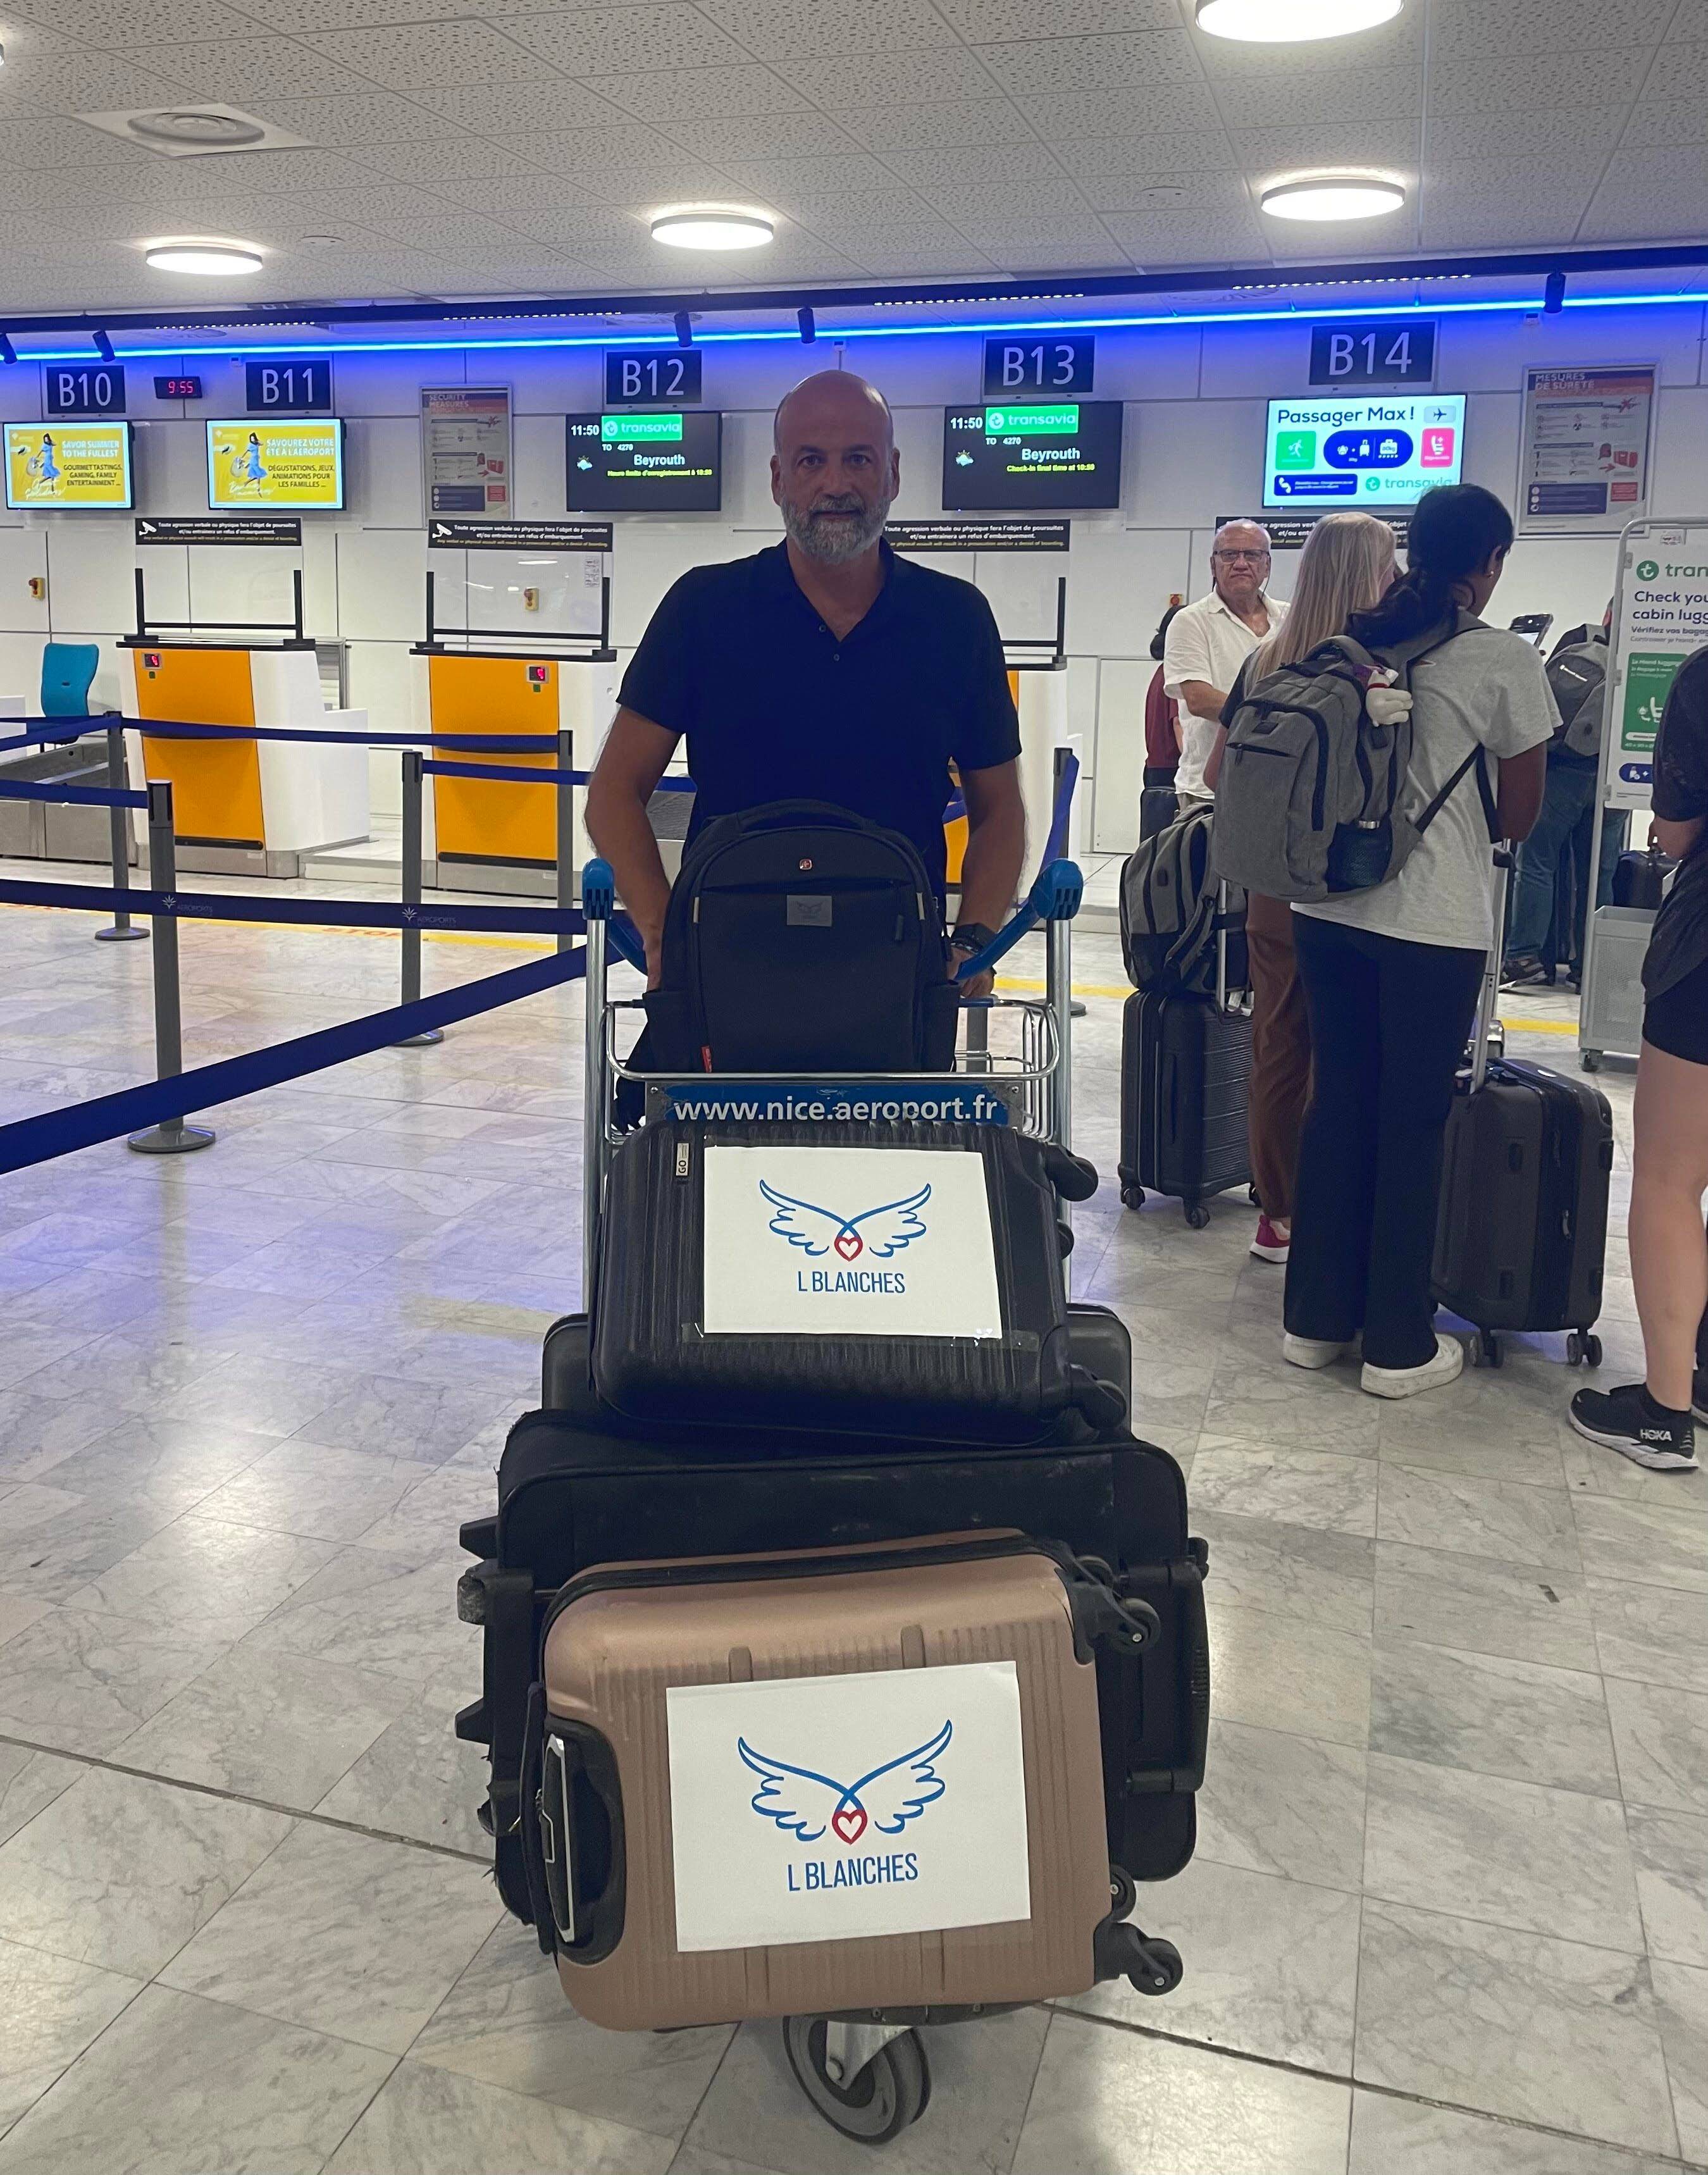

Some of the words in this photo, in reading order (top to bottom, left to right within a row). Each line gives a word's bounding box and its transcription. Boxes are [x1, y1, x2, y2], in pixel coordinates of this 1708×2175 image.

[1329, 332, 1413, 376] B14
[1003, 344, 1075, 387] B13
[622, 358, 684, 397] B12
[1536, 372, 1585, 382] MESURES
[59, 373, 111, 407] B10
[168, 381, 194, 393] 9:55
[263, 368, 313, 404] B11
[1535, 382, 1550, 390] DE
[950, 417, 983, 429] 11:50
[1008, 413, 1076, 425] transavia
[1278, 409, 1363, 428] Passager
[1368, 407, 1406, 421] Max
[571, 424, 600, 436] 11:50
[621, 422, 680, 433] transavia
[1003, 437, 1022, 445] 4270
[88, 449, 118, 457] FULLEST
[1021, 448, 1080, 462] Beyrouth
[634, 454, 686, 468] Beyrouth
[1635, 591, 1681, 602] Check
[1633, 609, 1674, 620] cabin
[1631, 626, 1664, 634] Vérifiez
[674, 1094, 998, 1122] www.nice.aeroport.fr
[678, 1160, 687, 1174] GO
[798, 1271, 808, 1292] L
[812, 1272, 906, 1294] BLANCHES
[1640, 1428, 1672, 1441] HOKA
[788, 1864, 801, 1892] L
[806, 1852, 919, 1890] BLANCHES
